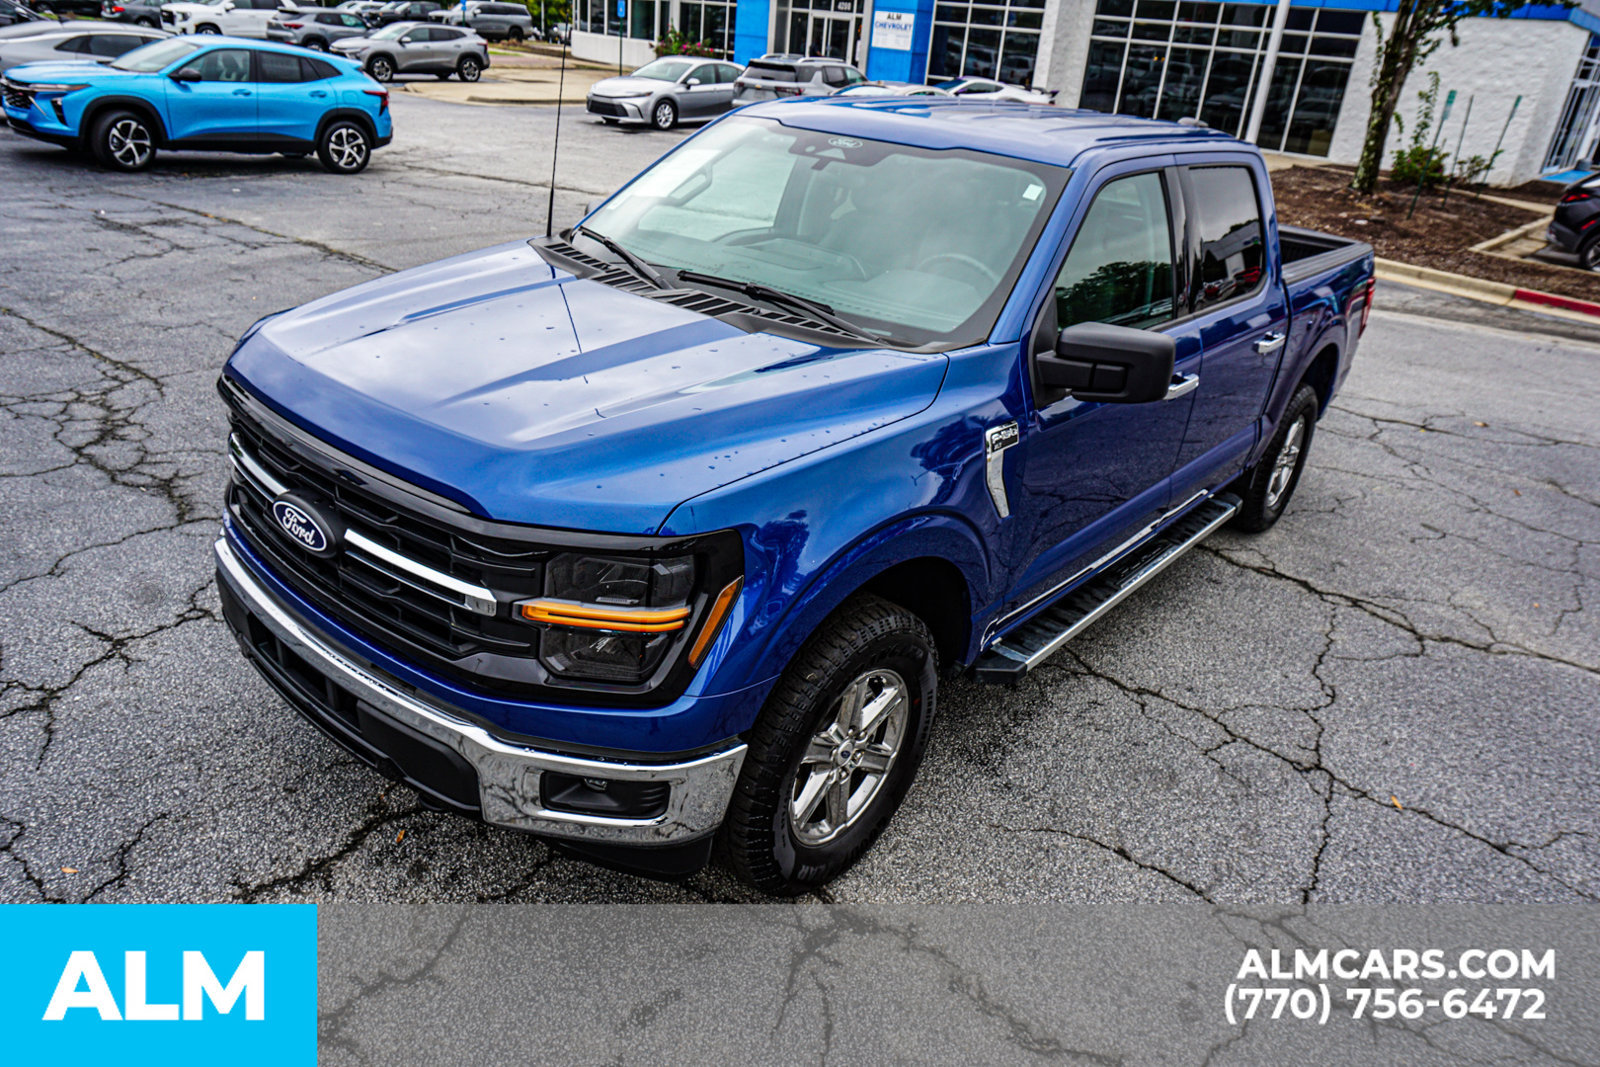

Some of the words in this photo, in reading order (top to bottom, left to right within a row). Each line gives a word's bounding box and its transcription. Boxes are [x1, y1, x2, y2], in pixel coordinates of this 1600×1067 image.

[874, 21, 912, 30] CHEVROLET
[283, 507, 315, 545] Ford
[919, 688, 935, 747] TERRITORY
